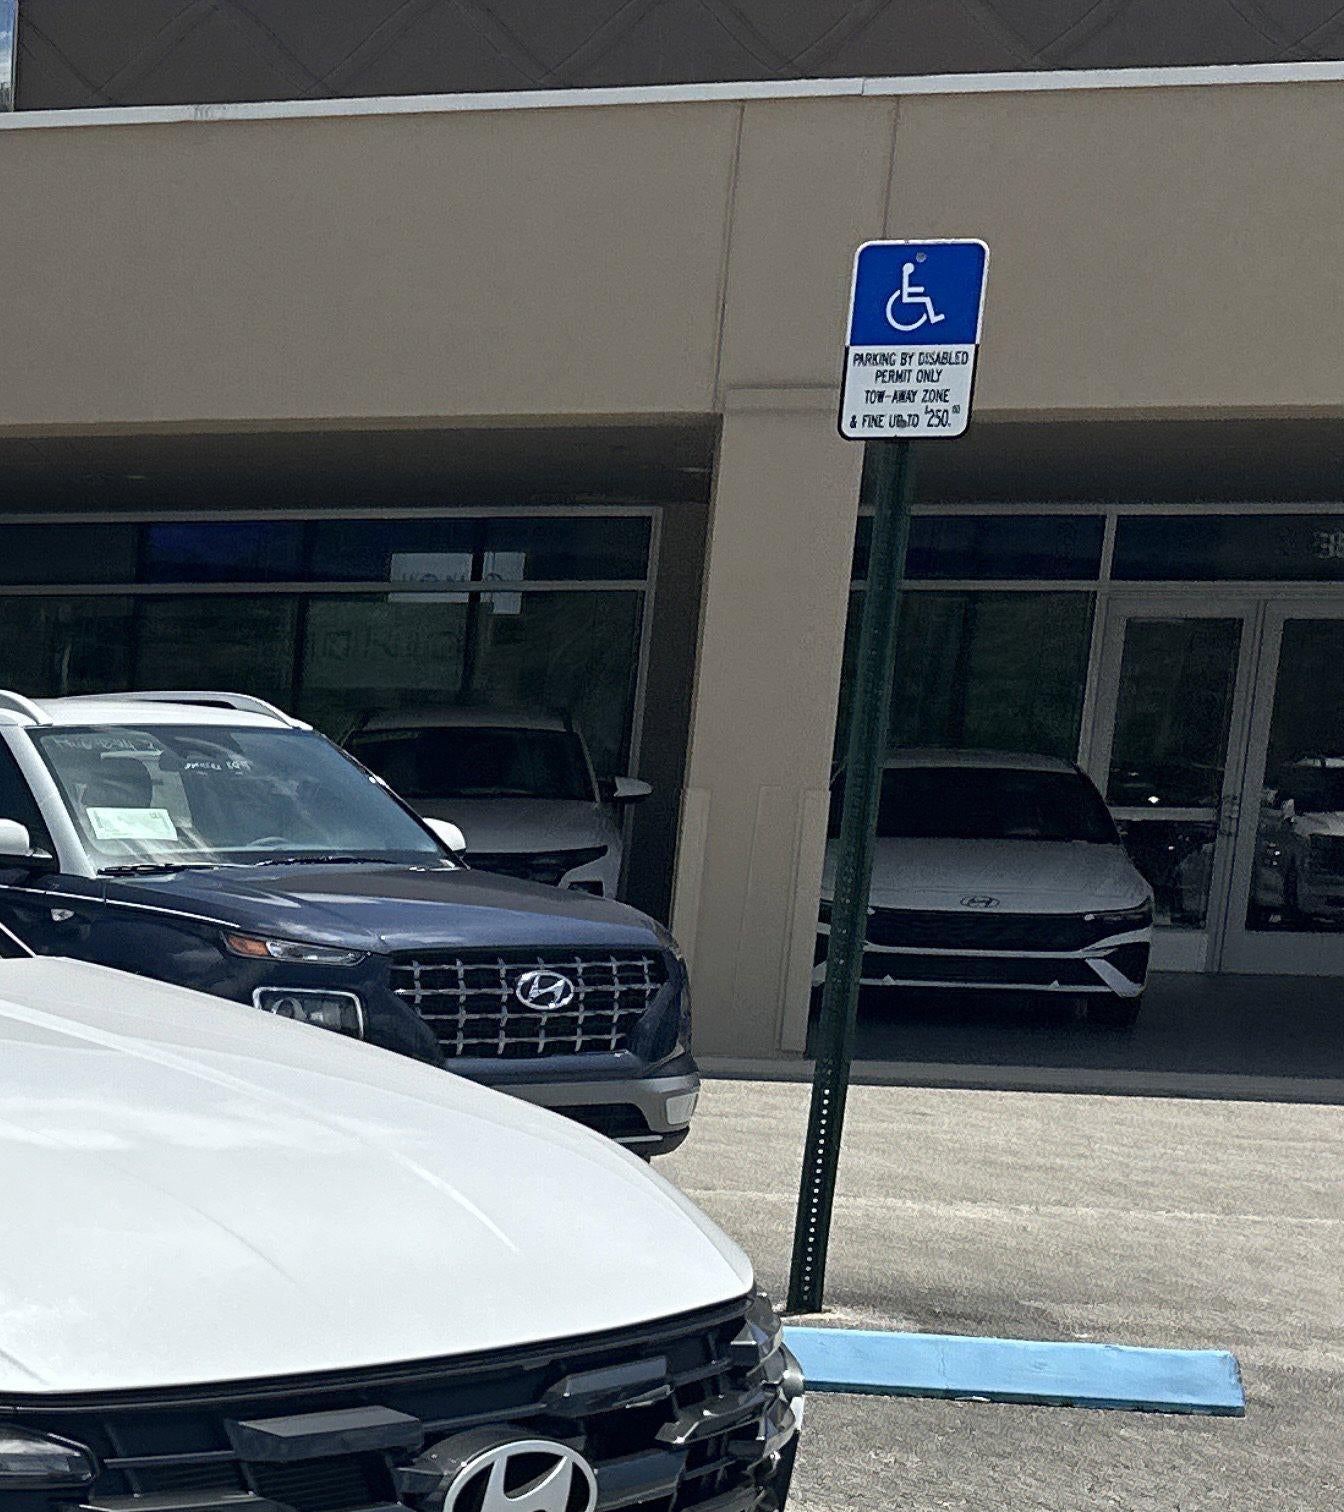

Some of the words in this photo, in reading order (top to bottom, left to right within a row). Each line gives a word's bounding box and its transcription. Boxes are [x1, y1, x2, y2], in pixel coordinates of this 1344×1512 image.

[852, 351, 897, 367] PARKING
[900, 352, 915, 367] BY
[917, 350, 969, 366] DISABLED
[874, 368, 913, 384] PERMIT
[916, 368, 944, 383] ONLY
[864, 388, 919, 404] TOW-AWAY
[921, 388, 951, 404] ZONE
[849, 414, 858, 429] &
[861, 413, 885, 429] FINE
